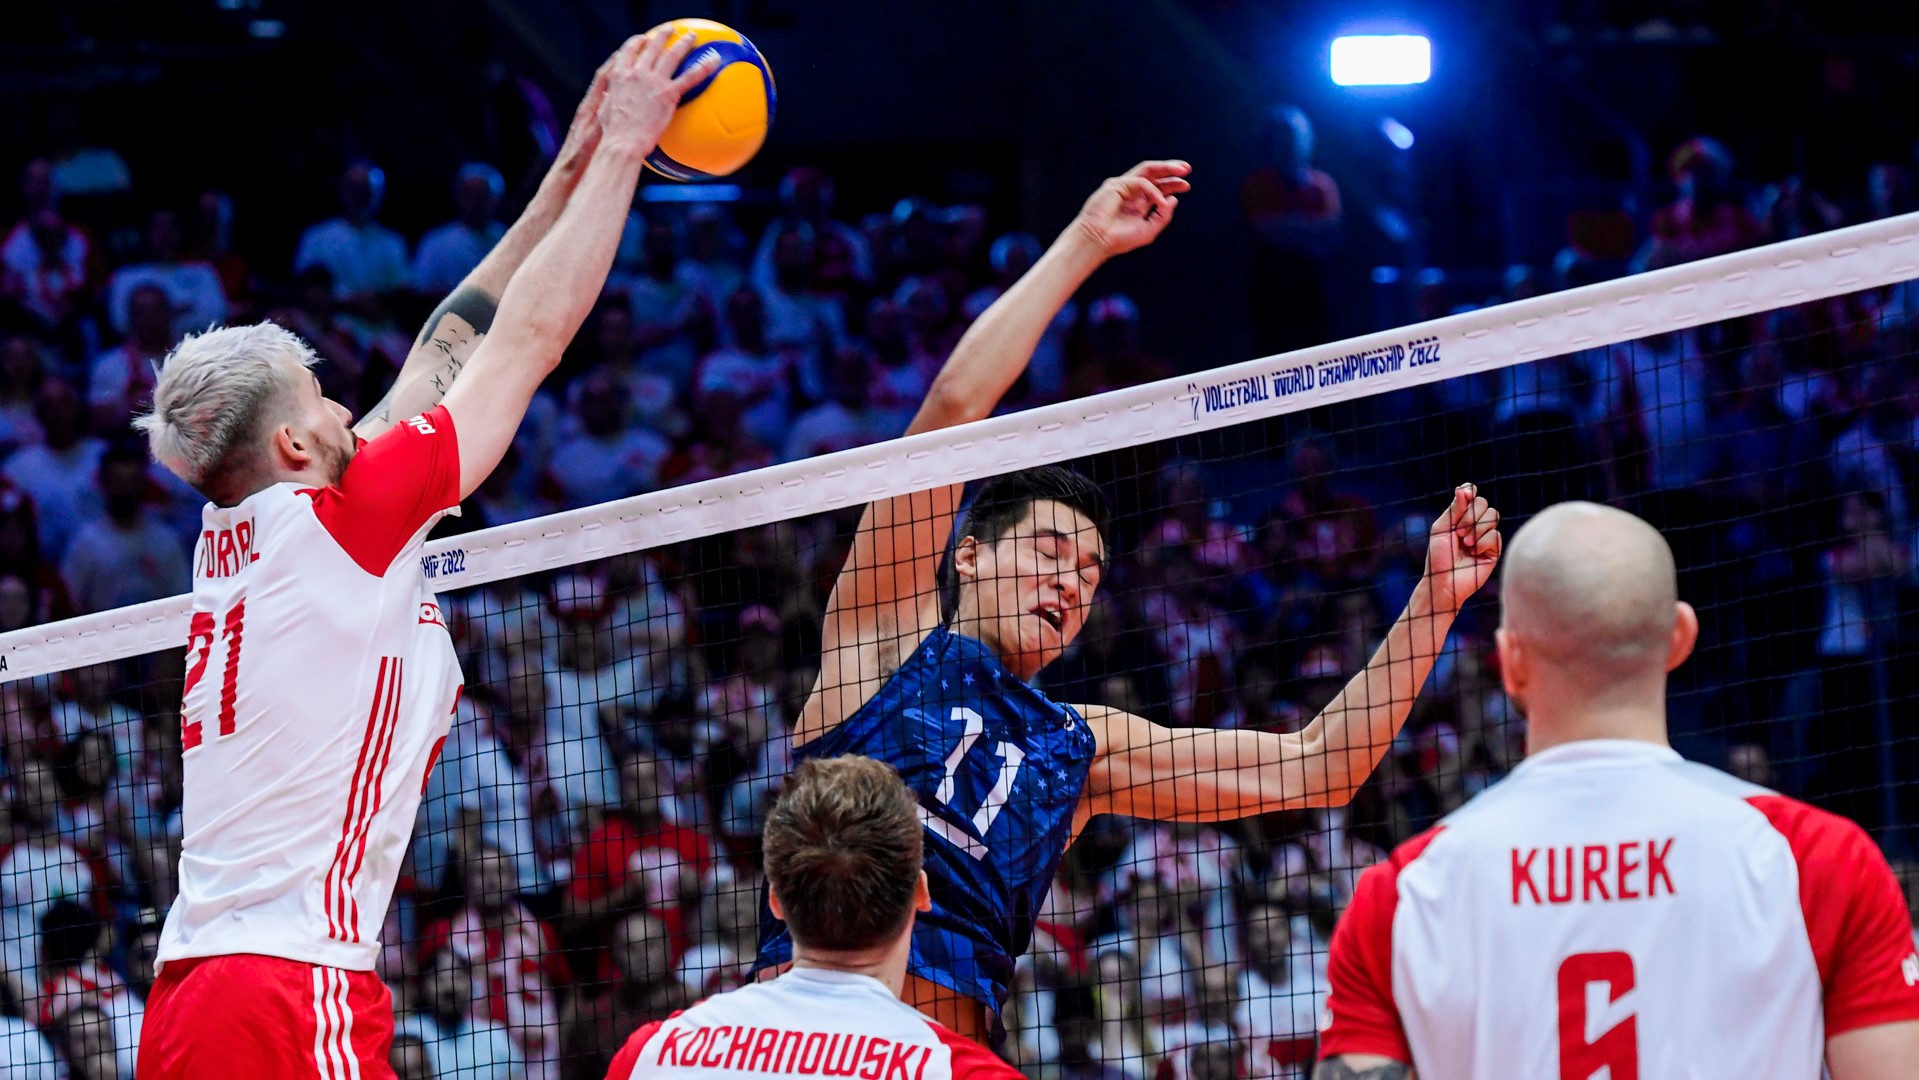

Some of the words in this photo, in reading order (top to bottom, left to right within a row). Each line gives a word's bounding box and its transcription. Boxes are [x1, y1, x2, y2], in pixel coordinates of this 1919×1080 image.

[1202, 374, 1269, 413] VOLLEYBALL
[1271, 365, 1315, 398] WORLD
[1316, 344, 1405, 387] CHAMPIONSHIP
[1408, 336, 1441, 368] 2022
[196, 516, 260, 578] ORAL
[441, 548, 465, 576] 2022
[181, 596, 246, 750] 21
[1511, 837, 1676, 906] KUREK
[1557, 951, 1639, 1080] 6
[656, 1025, 932, 1080] KOCHANOWSKI
